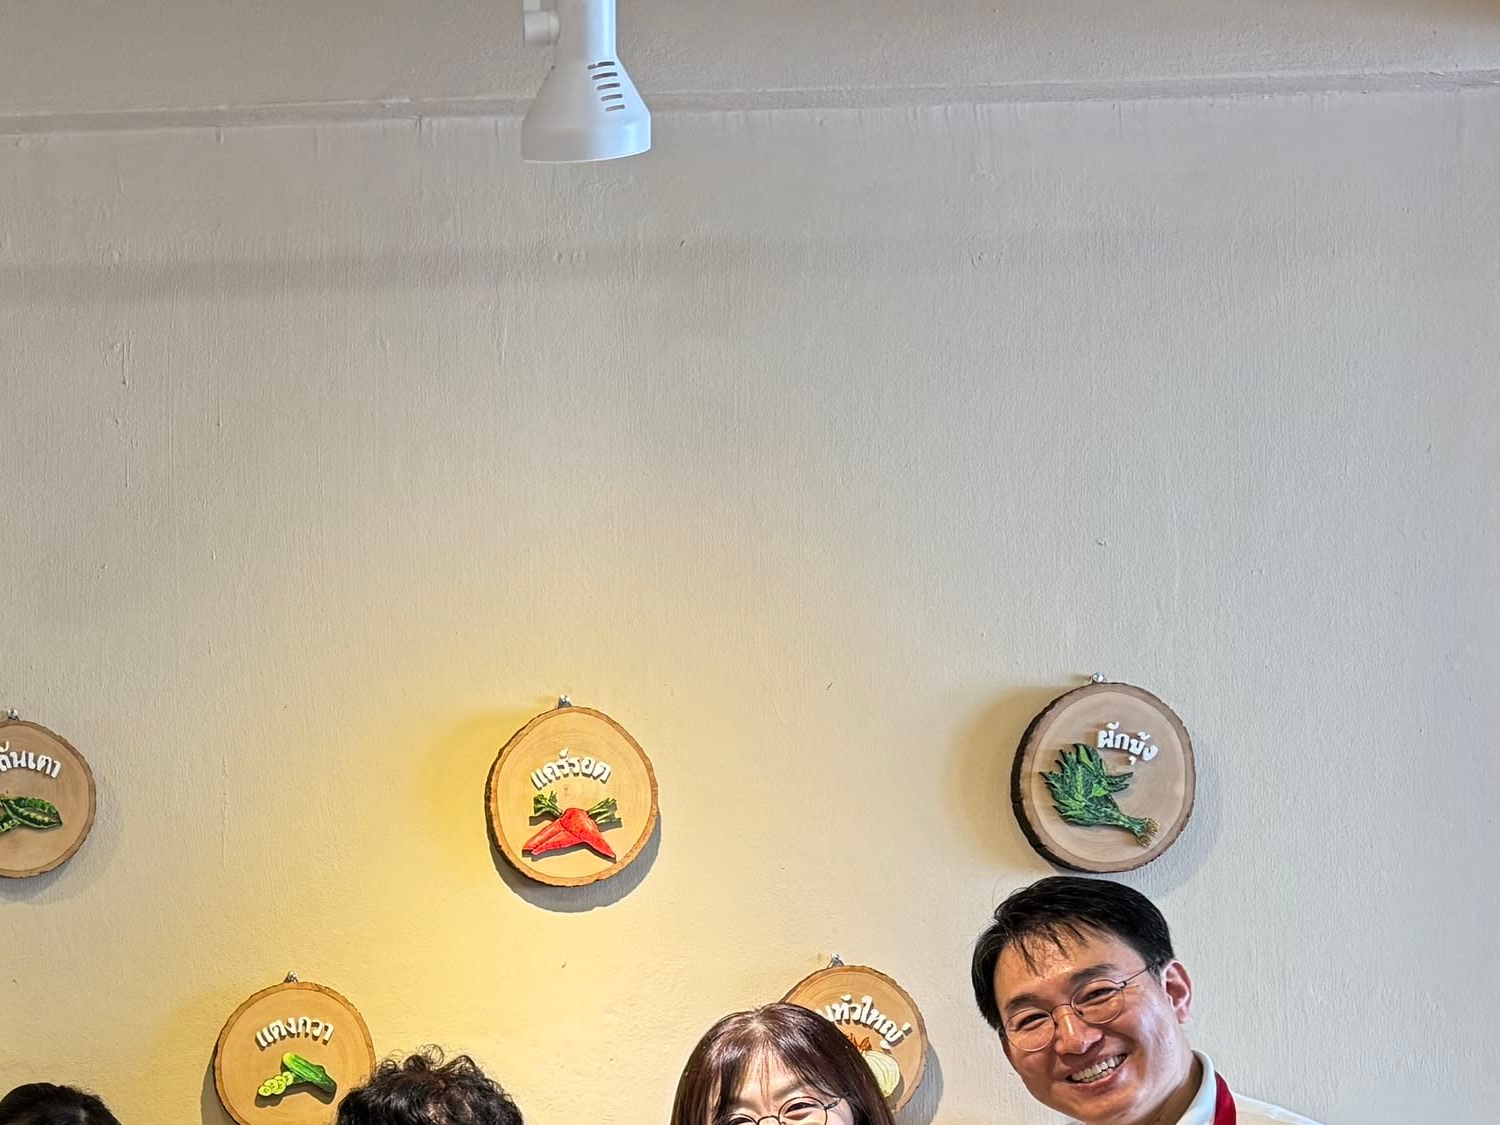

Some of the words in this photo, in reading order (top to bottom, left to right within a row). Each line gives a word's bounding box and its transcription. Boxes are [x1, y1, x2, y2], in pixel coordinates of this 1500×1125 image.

[1097, 722, 1159, 766] ผักบุ้ง
[255, 1016, 334, 1048] แตงกวา
